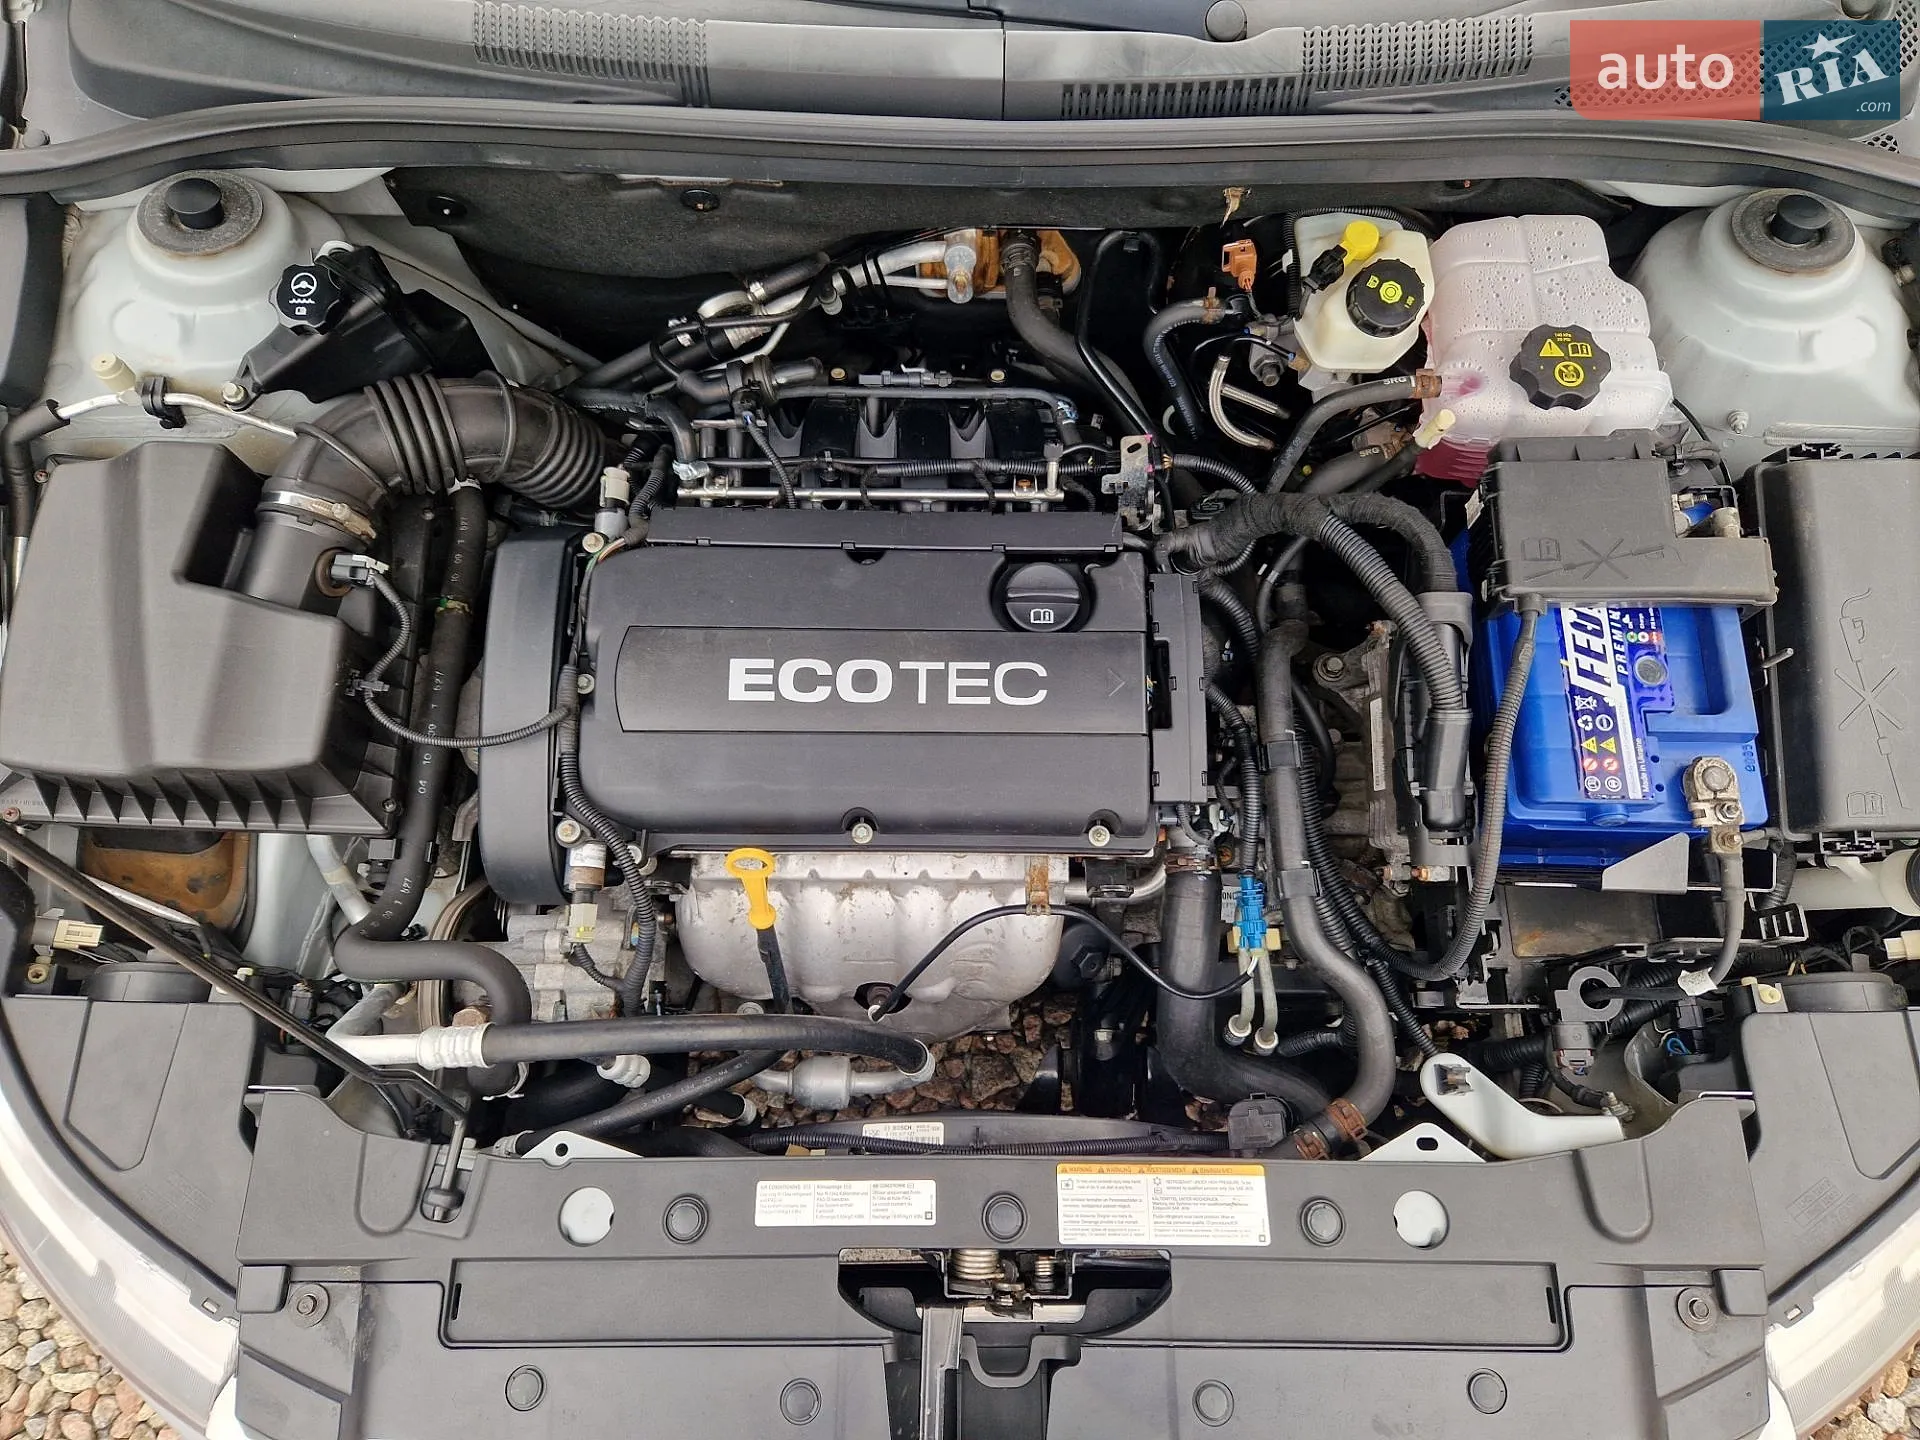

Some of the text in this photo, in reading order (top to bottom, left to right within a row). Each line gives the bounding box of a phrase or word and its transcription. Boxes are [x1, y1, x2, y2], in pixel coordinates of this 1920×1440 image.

[1383, 376, 1407, 385] SRG
[1360, 447, 1380, 457] SRG
[1608, 608, 1629, 675] PREMIU
[728, 658, 1048, 706] ECOTEC
